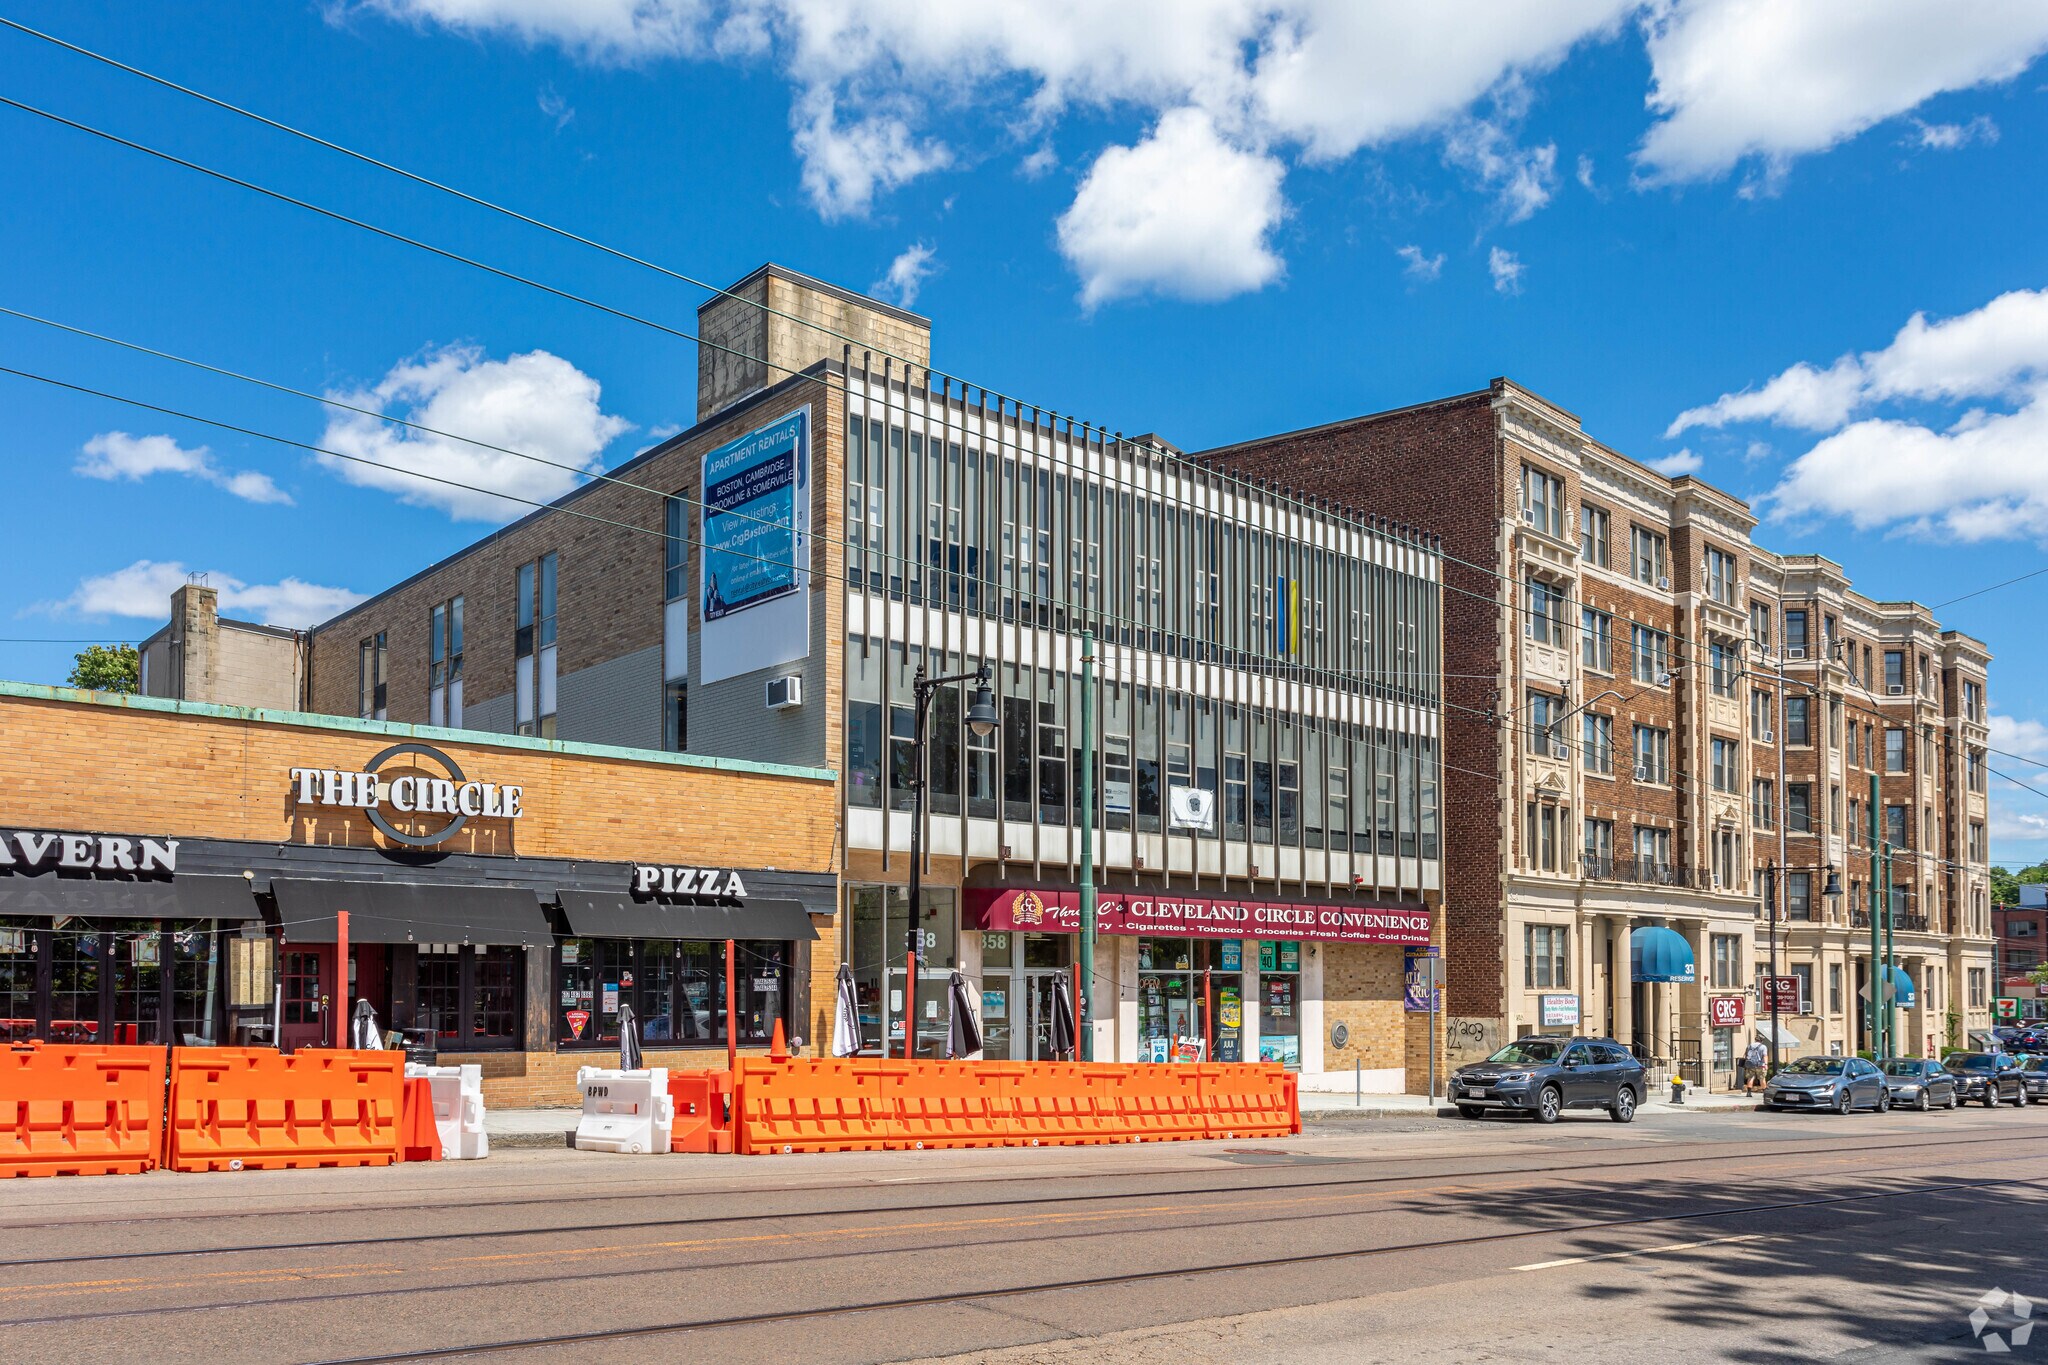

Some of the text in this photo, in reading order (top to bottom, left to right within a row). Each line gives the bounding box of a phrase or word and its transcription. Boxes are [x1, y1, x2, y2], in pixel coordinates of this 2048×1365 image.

[709, 425, 796, 475] APARTMENT RENTALS
[709, 469, 794, 514] BROOKLINE & SOMERVILLE
[716, 477, 745, 497] BOSTON,
[722, 519, 739, 533] View
[290, 767, 523, 818] THE CIRCLE
[637, 866, 748, 897] PIZZA
[1045, 906, 1081, 919] Thre
[1131, 901, 1429, 930] CLEVELAND CIRCLE CONVENIENCE
[1062, 920, 1112, 931] Lory
[1126, 922, 1187, 932] Cigarettes
[1197, 925, 1244, 934] Tobacco
[1254, 928, 1304, 936] Groceries
[1310, 930, 1337, 938] Fresh
[1340, 931, 1370, 939] Coffee
[1401, 934, 1429, 942] Drinks
[1546, 997, 1576, 1006] Healthy Body
[1716, 1000, 1736, 1018] CRG
[587, 1086, 609, 1097] BPWD
